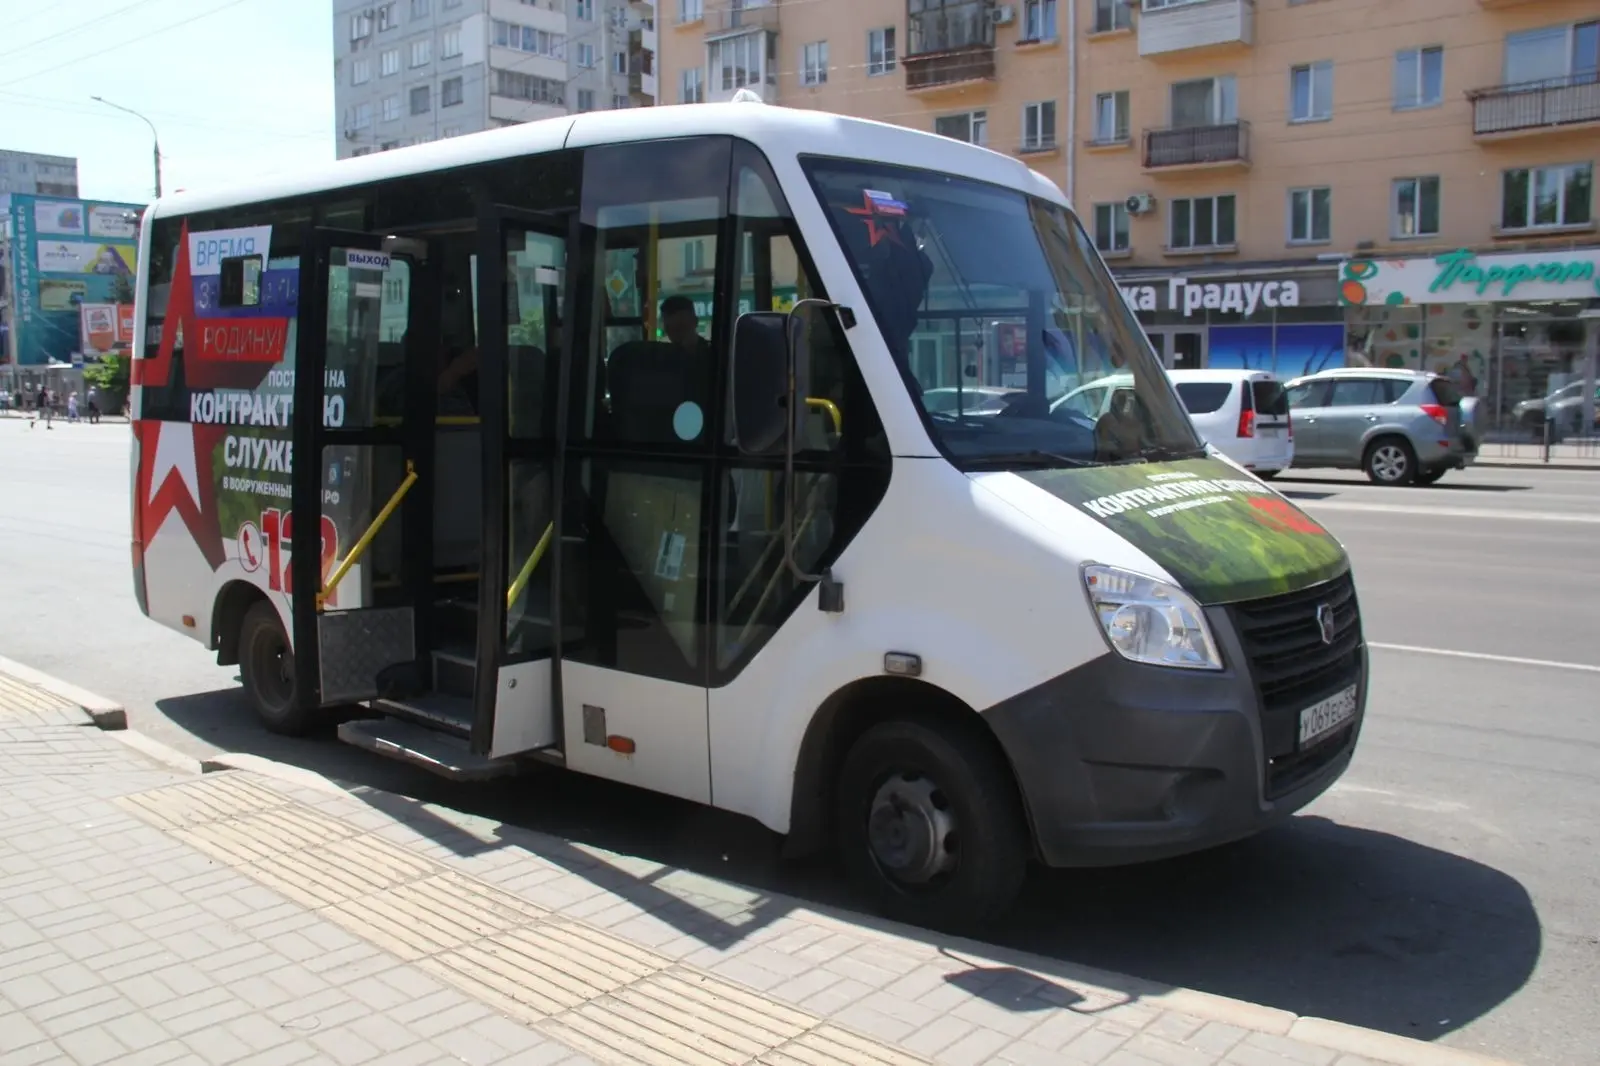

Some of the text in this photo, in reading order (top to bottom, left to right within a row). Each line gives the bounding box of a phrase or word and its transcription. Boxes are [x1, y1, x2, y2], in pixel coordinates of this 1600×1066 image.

[347, 251, 390, 266] ВЫХОД
[1428, 247, 1596, 297] Парфюм
[1168, 277, 1300, 319] Градуса
[203, 326, 282, 361] РОДИНУ!
[329, 370, 346, 388] НА
[223, 476, 229, 490] В
[324, 489, 341, 505] РФ
